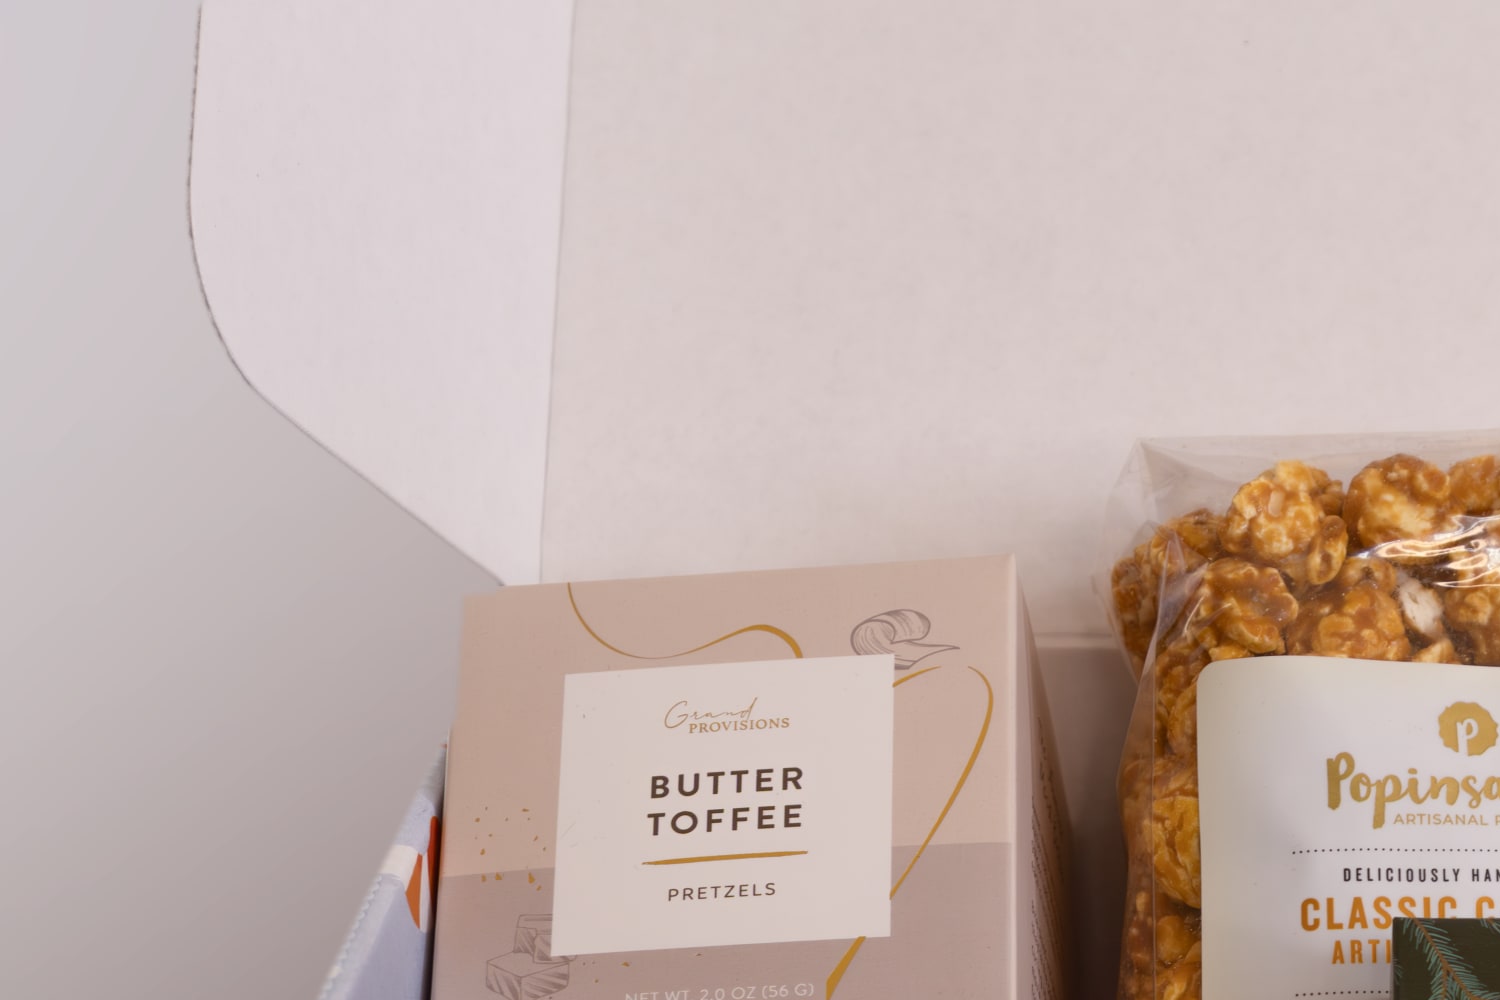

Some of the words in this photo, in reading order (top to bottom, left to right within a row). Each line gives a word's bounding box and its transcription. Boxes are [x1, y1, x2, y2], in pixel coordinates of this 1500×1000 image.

[664, 697, 758, 729] Grand
[688, 717, 791, 734] PROVISIONS
[650, 766, 803, 799] BUTTER
[647, 804, 803, 836] TOFFEE
[1393, 812, 1489, 826] ARTISANAL
[1343, 867, 1460, 883] DELICIOUSLY
[667, 882, 777, 902] PRETZELS
[1331, 938, 1393, 965] ARTI
[731, 985, 757, 1000] OZ
[761, 984, 790, 1000] (56
[794, 982, 815, 998] G)
